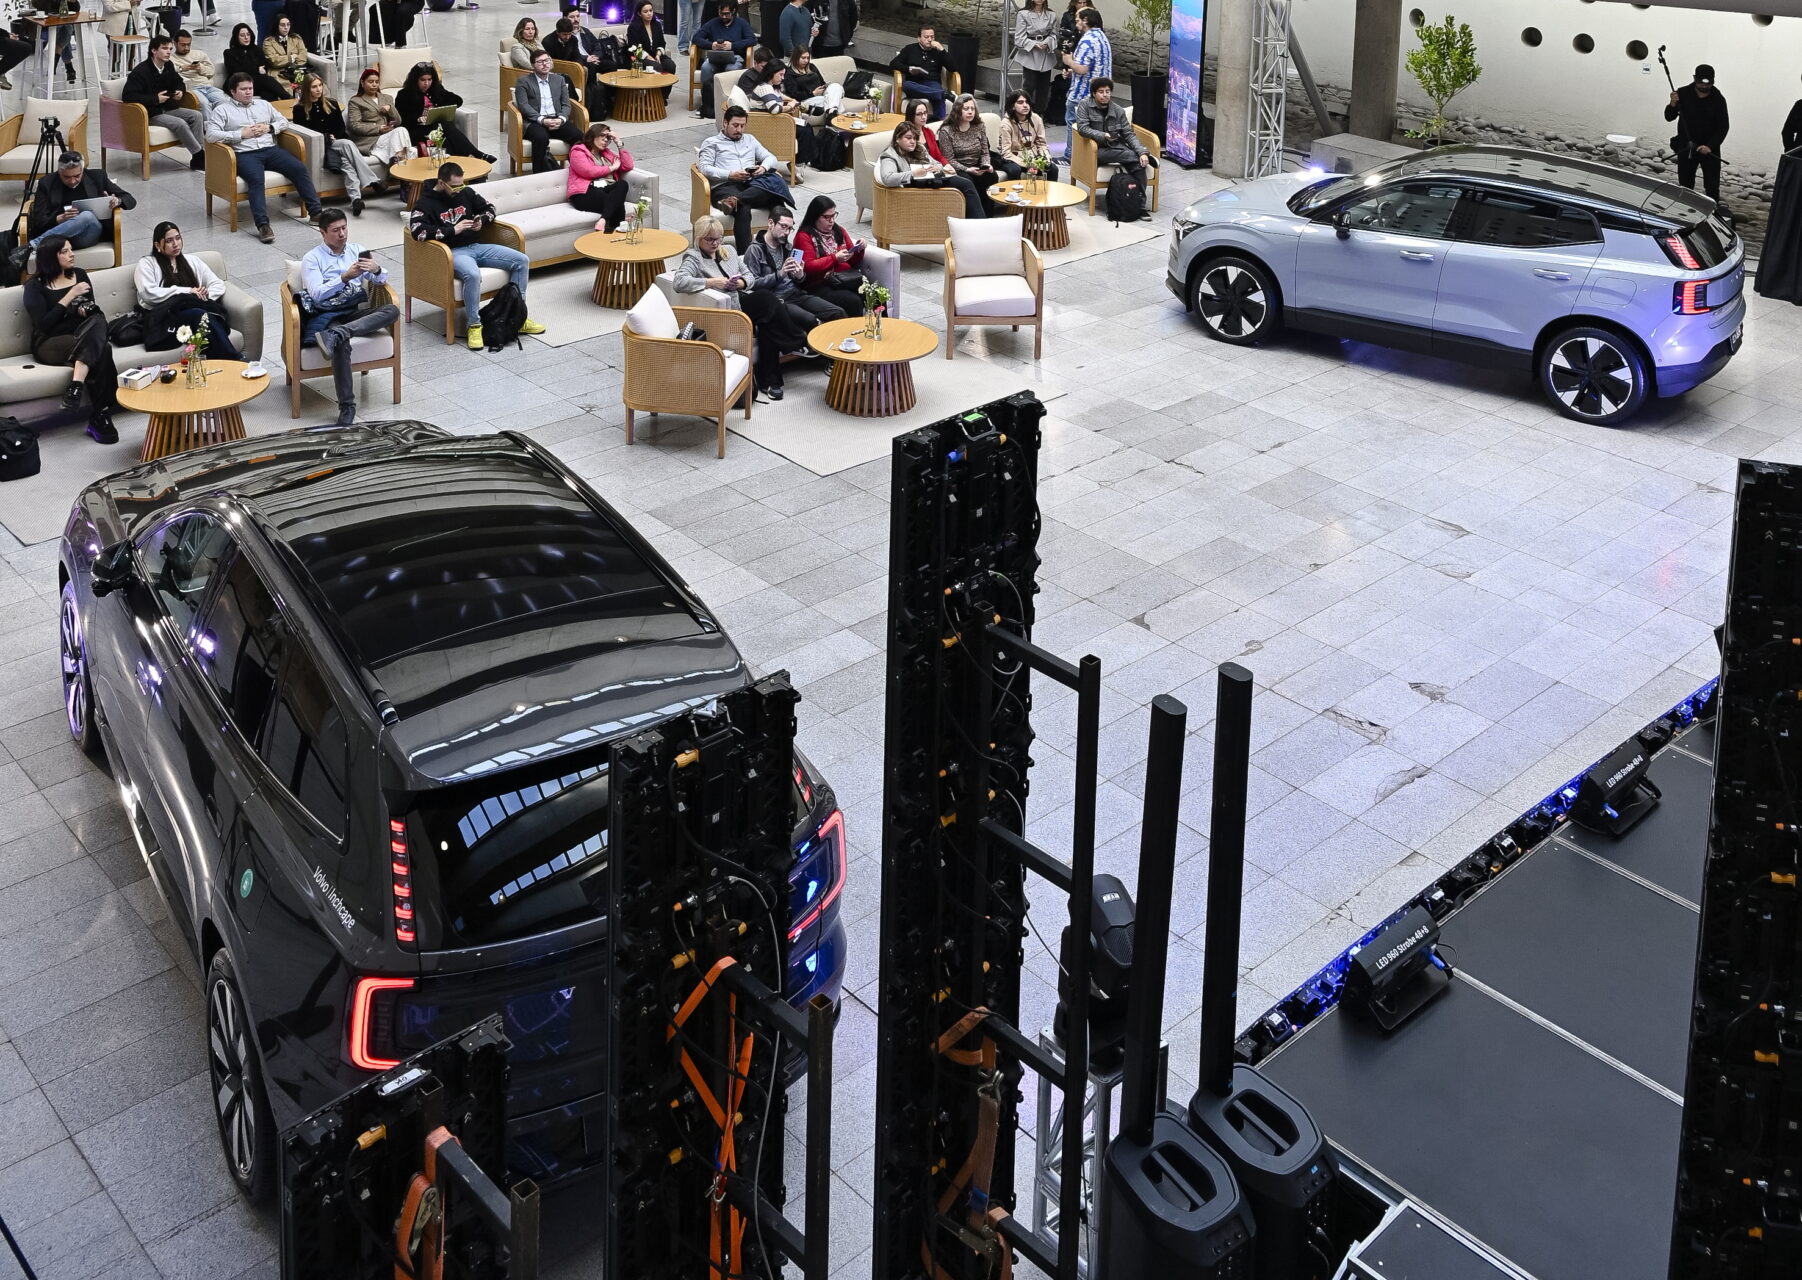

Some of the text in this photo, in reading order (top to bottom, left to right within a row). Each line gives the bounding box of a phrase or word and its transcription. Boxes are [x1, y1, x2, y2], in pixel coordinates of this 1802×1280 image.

[1606, 777, 1617, 788] LED
[313, 865, 329, 893] Volvo
[327, 888, 356, 929] Inchcape
[1375, 925, 1430, 970] LED 960 Strobe 48+8
